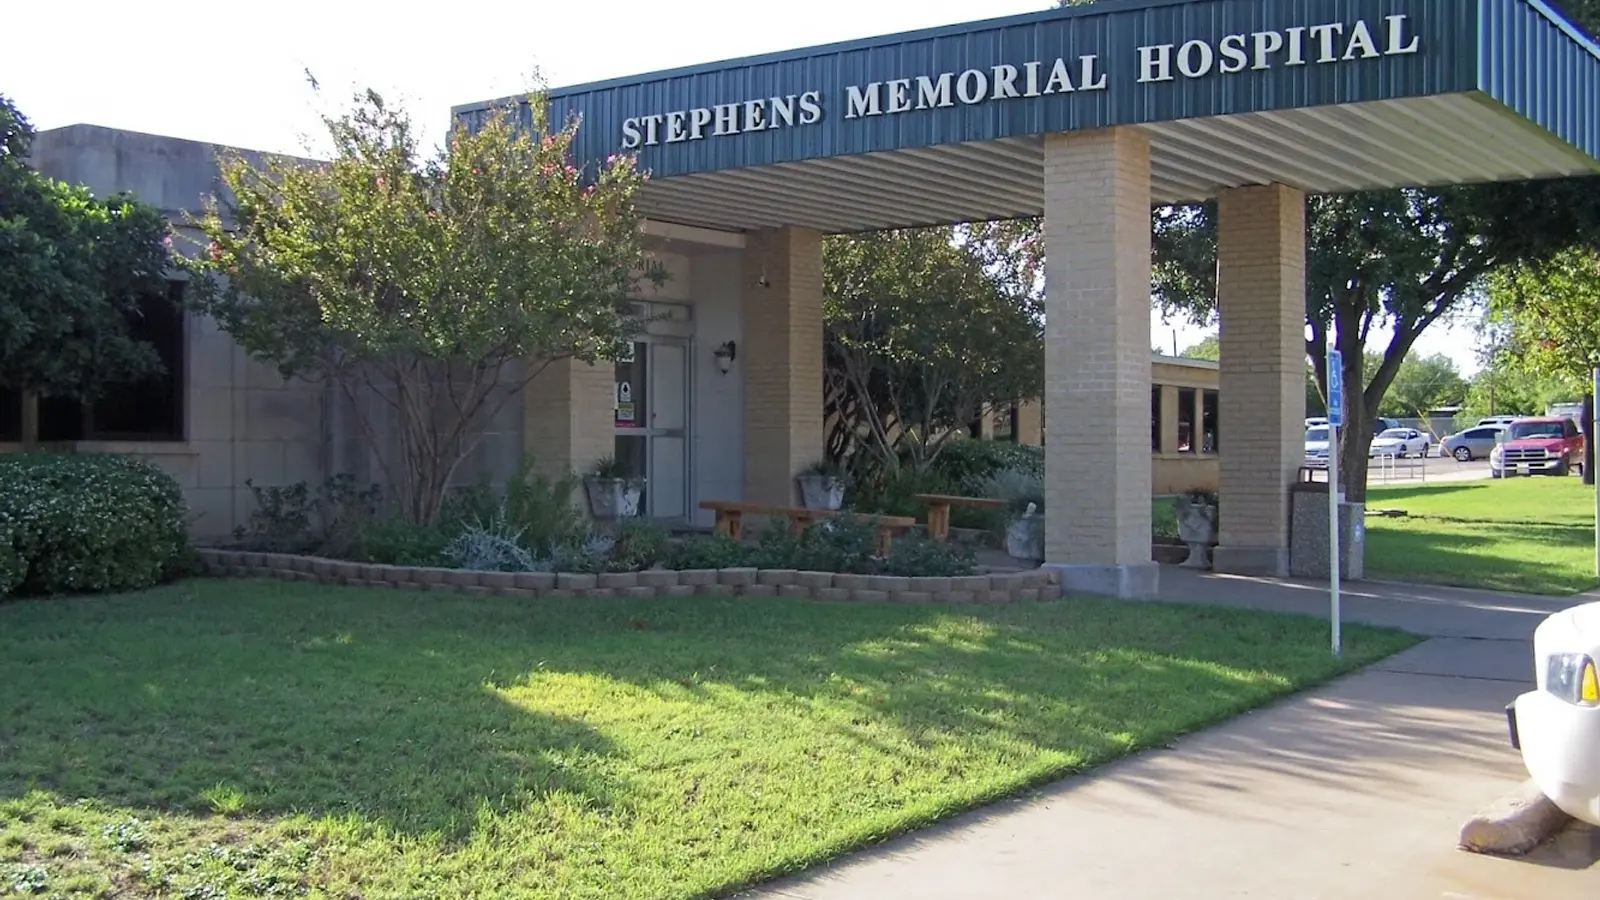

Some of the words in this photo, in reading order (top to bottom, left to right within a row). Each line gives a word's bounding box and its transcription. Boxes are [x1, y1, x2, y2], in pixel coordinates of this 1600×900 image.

[621, 89, 821, 150] STEPHENS
[844, 54, 1108, 120] MEMORIAL
[1136, 14, 1419, 83] HOSPITAL
